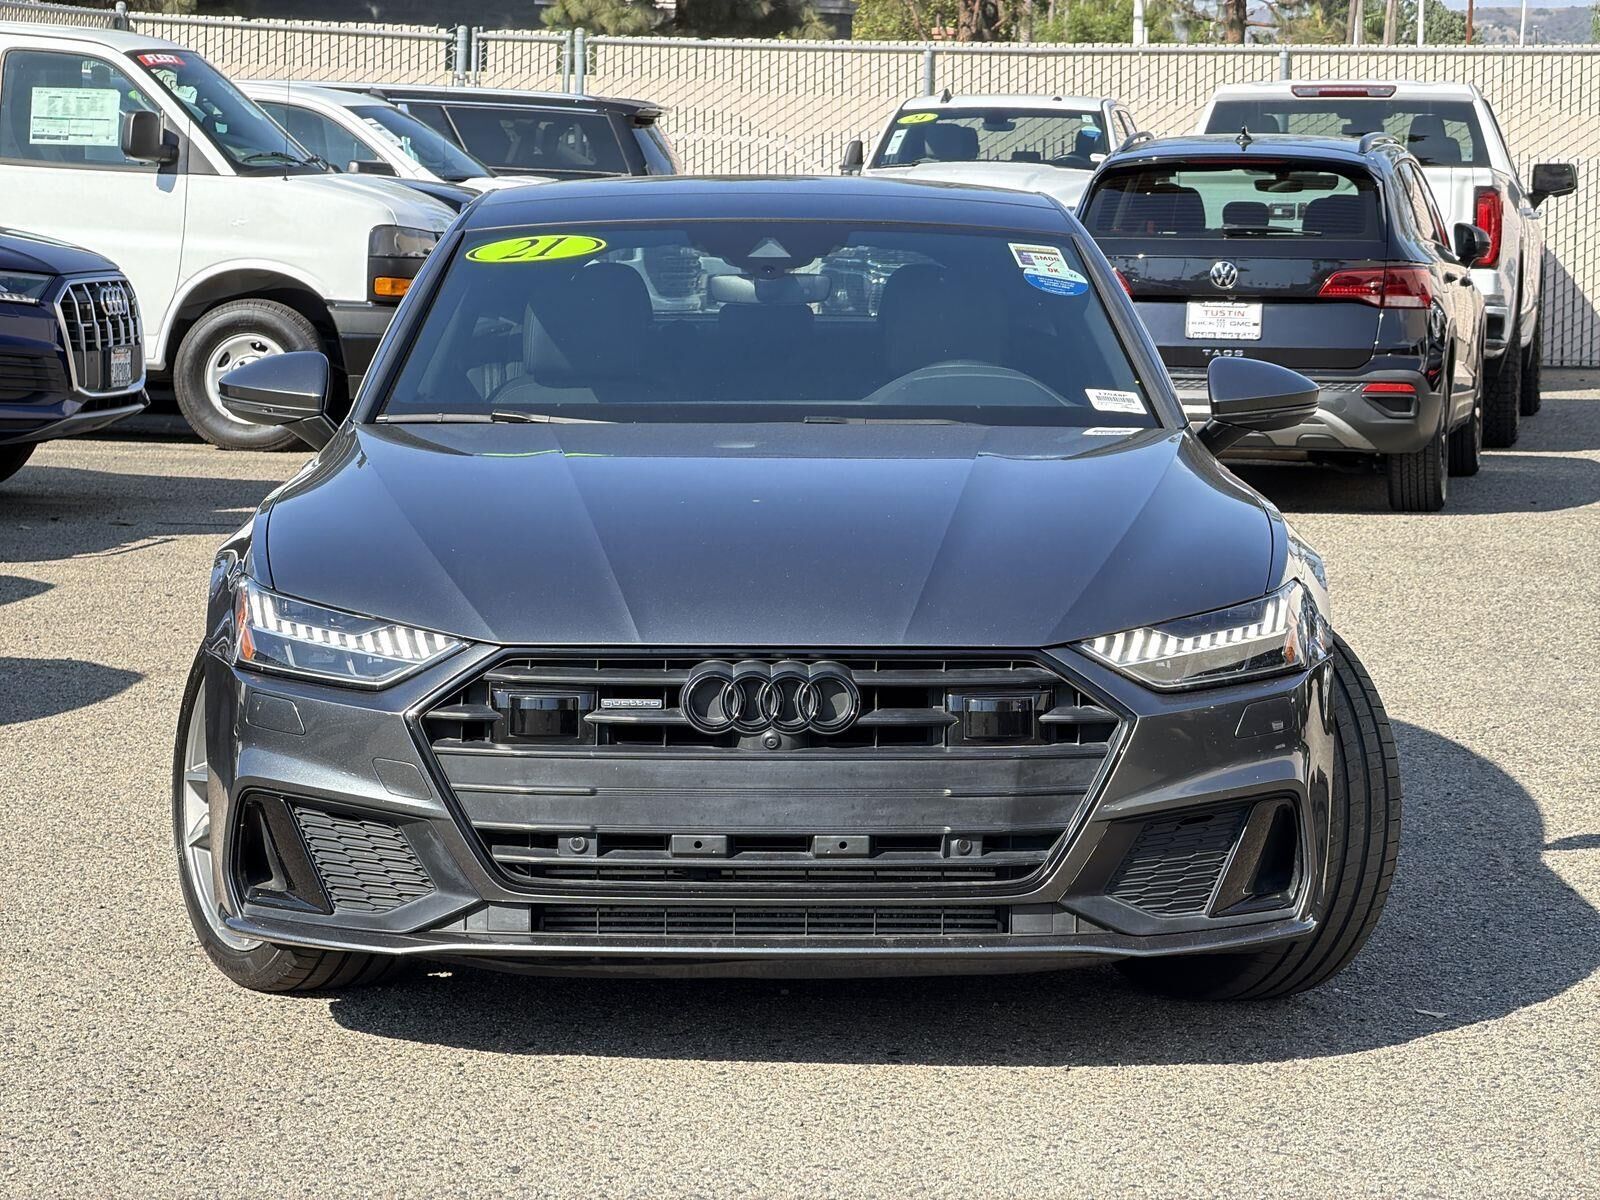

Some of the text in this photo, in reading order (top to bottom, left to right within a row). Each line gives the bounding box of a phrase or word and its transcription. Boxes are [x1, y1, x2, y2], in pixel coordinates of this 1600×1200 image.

[143, 54, 181, 64] FLEET
[497, 236, 569, 260] 21
[1203, 309, 1246, 317] TUSTIN
[1202, 349, 1244, 357] TAOS
[602, 700, 660, 708] quattro
